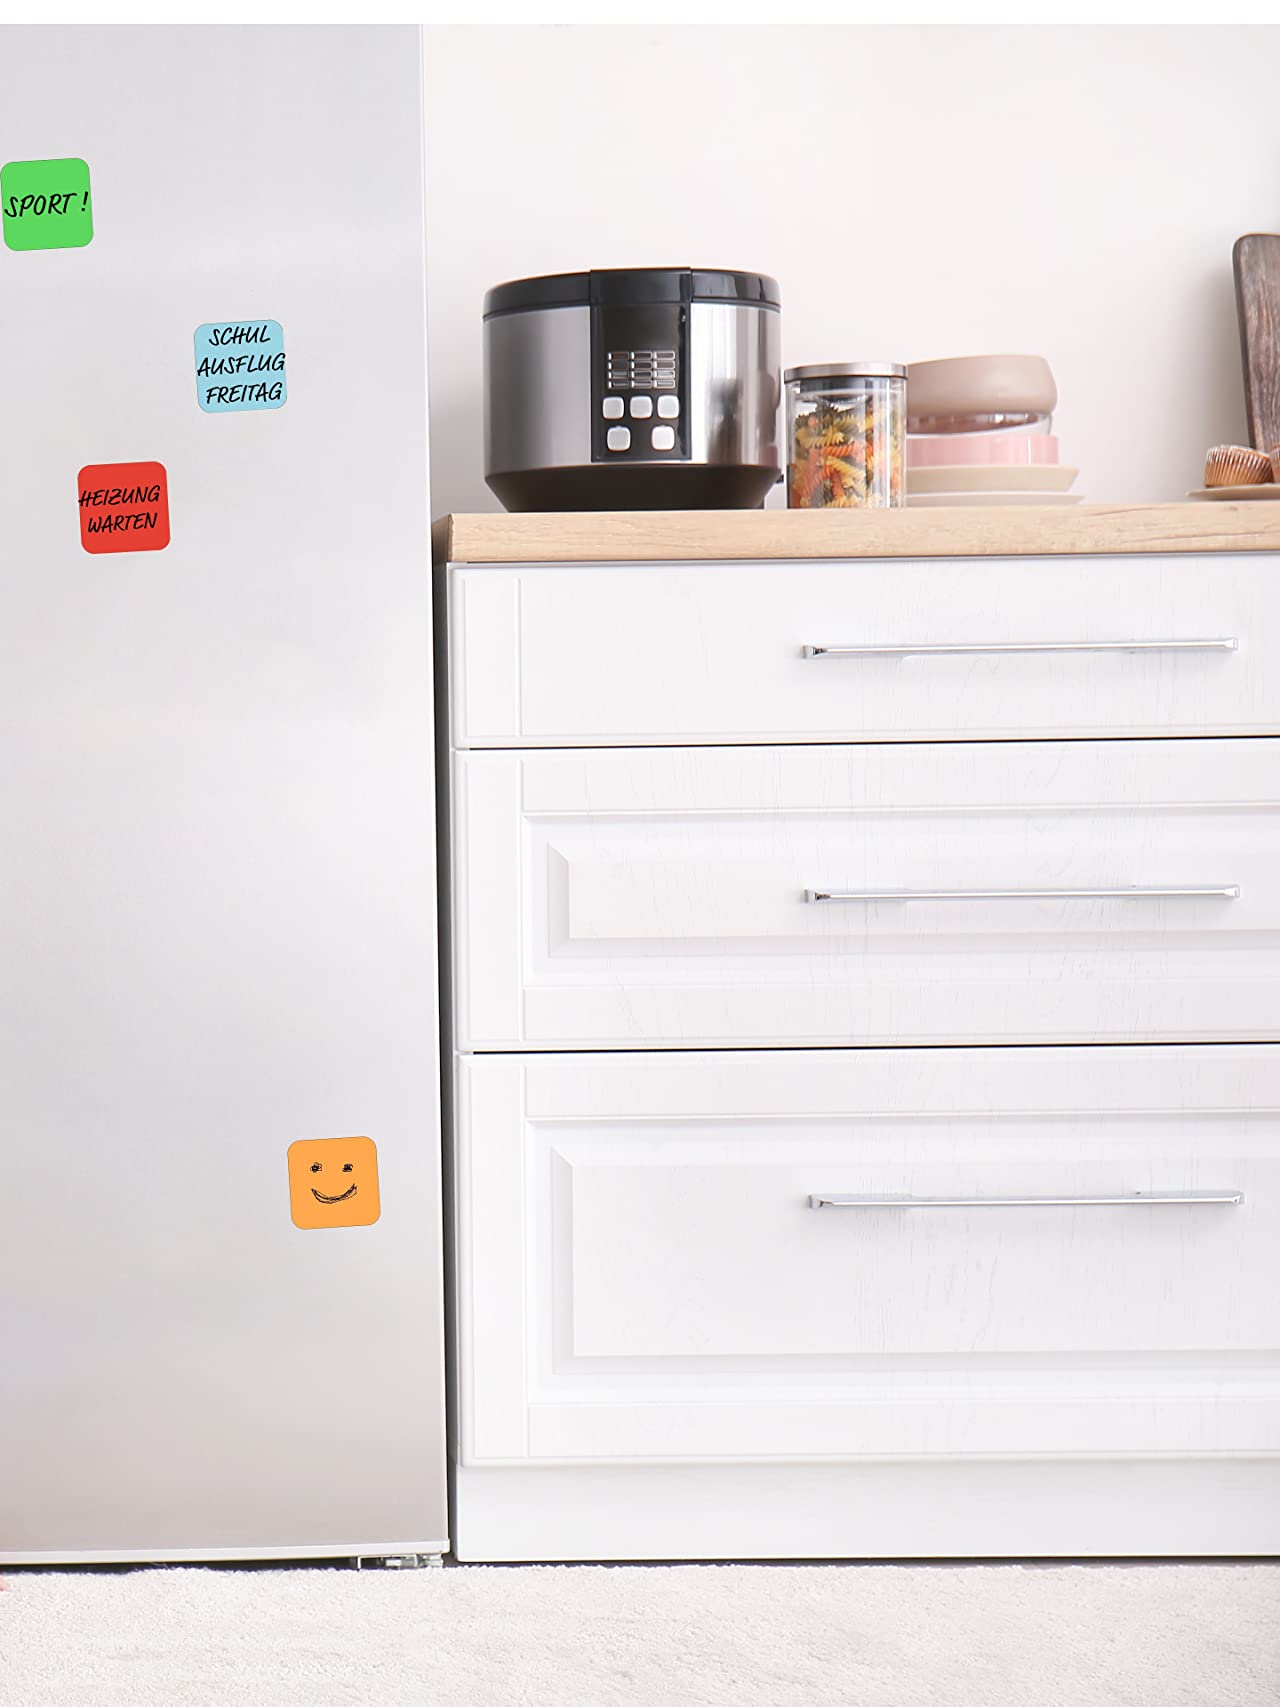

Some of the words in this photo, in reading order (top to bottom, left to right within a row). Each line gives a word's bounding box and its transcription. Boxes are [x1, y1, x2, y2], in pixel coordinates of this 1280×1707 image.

[207, 324, 271, 347] SCHUL
[196, 352, 286, 378] AUSFLUG
[205, 381, 283, 405] FREITAG
[77, 484, 161, 508] HEIZUNG
[87, 512, 158, 533] WARTEN
